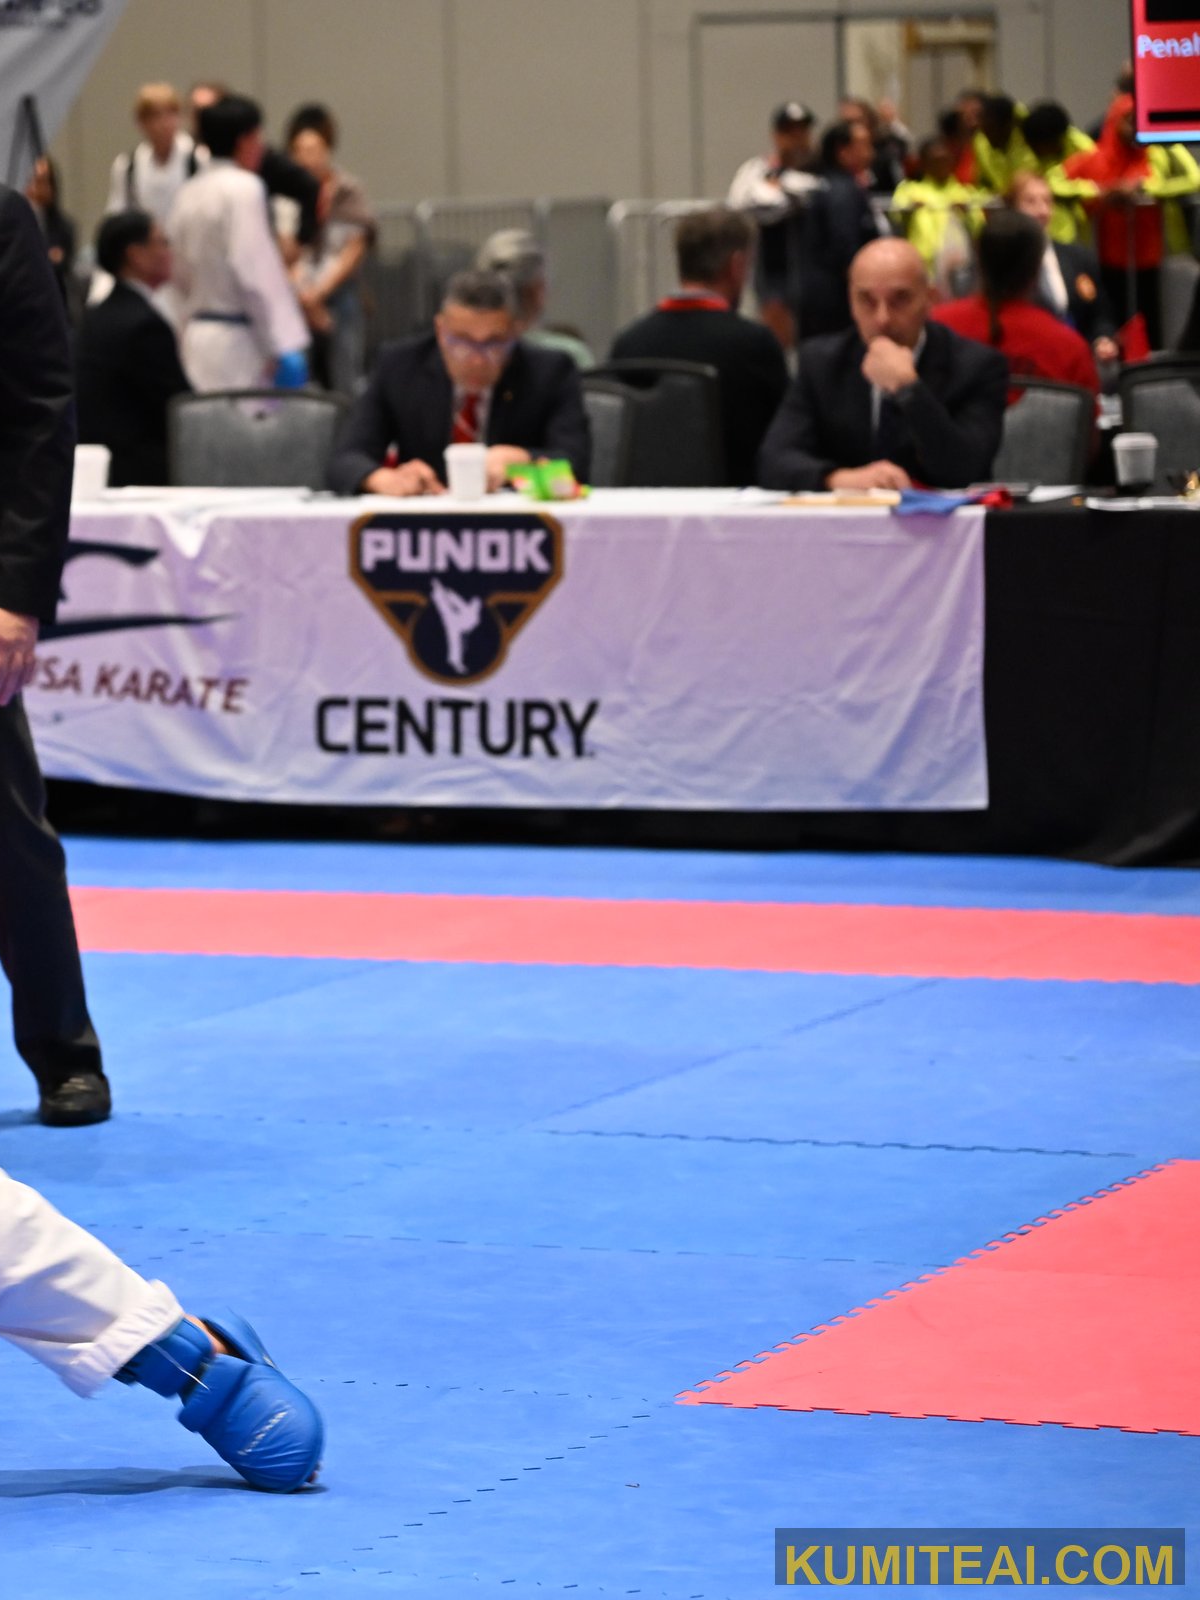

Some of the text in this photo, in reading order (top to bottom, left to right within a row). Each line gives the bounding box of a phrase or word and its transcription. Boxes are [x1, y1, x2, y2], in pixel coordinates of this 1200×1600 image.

[1136, 32, 1200, 59] Penal
[360, 528, 551, 572] PUNOK
[93, 662, 250, 715] KARATE
[315, 696, 599, 759] CENTURY
